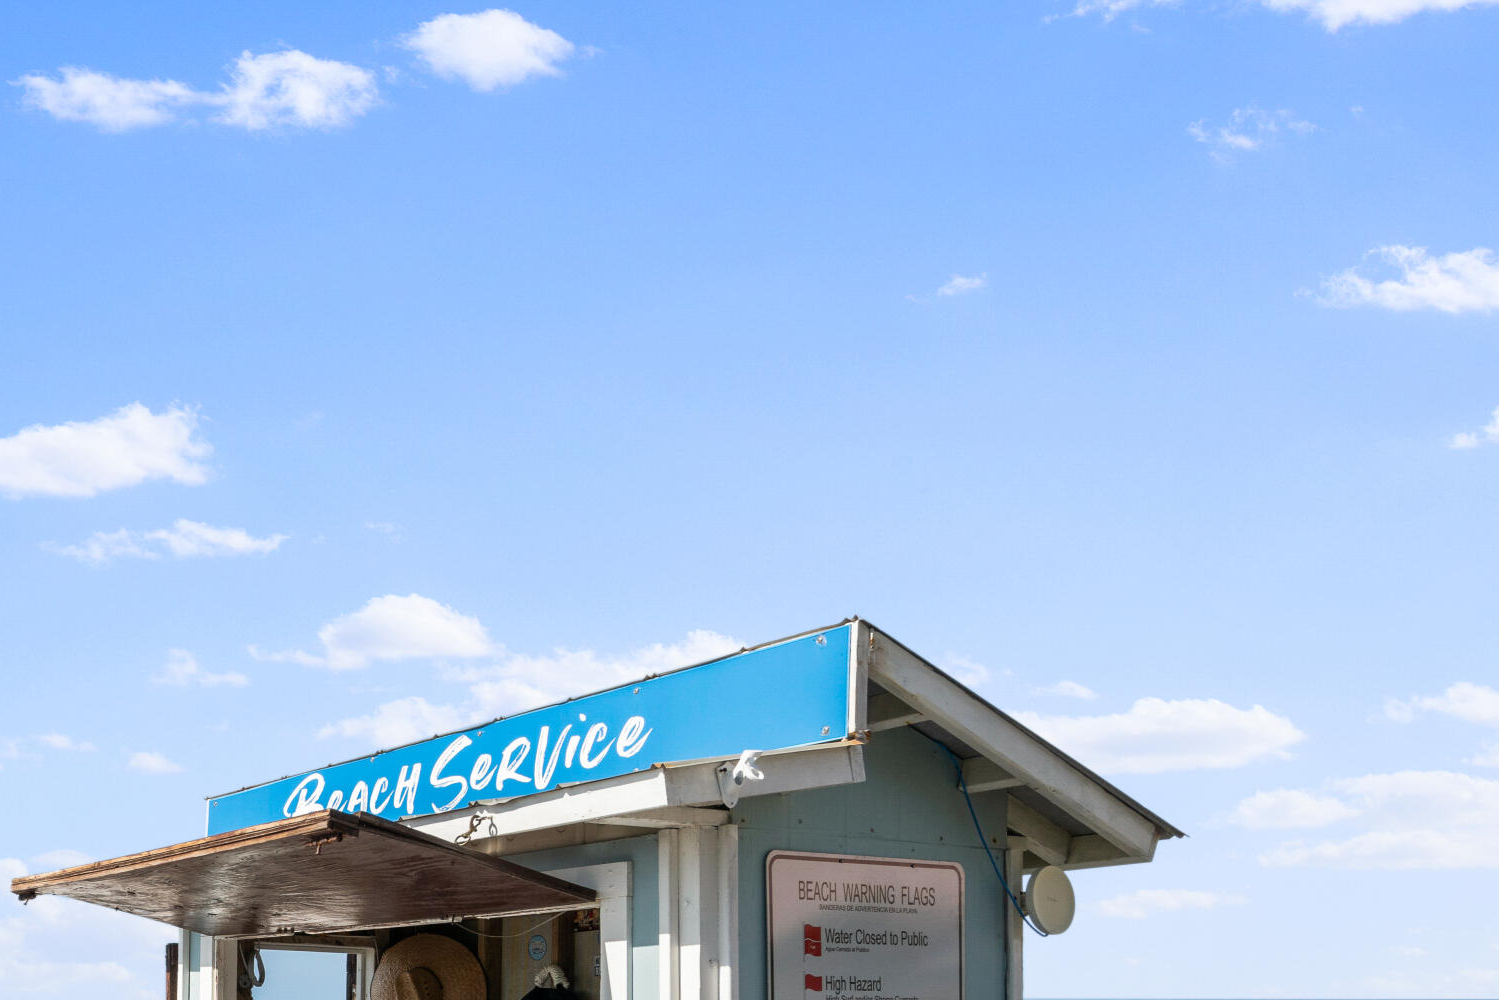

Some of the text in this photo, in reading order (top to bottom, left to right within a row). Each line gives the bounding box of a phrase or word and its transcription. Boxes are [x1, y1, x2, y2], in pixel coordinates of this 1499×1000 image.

[798, 880, 935, 906] BEACH WARNING FLAGS
[825, 927, 928, 946] Water Closed to Public
[826, 975, 881, 994] High Hazard
